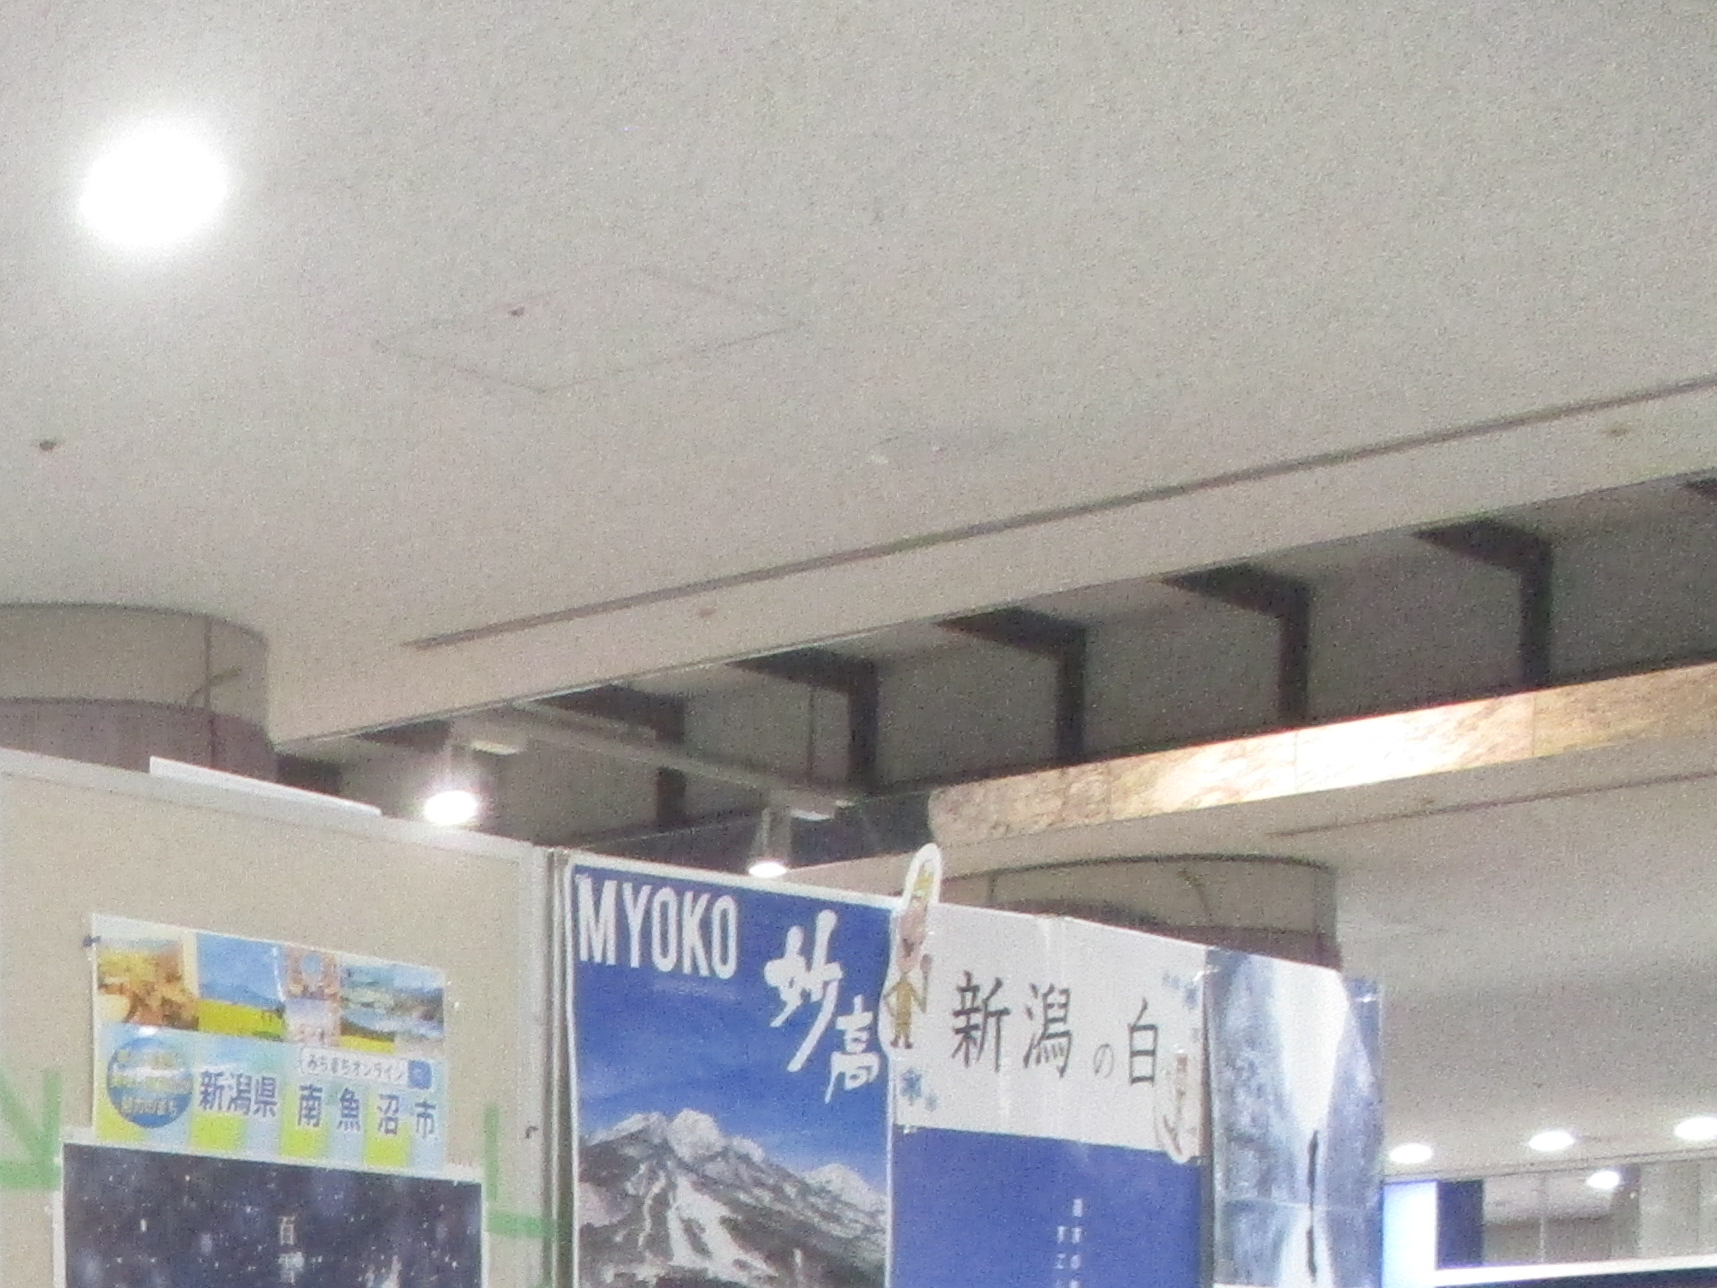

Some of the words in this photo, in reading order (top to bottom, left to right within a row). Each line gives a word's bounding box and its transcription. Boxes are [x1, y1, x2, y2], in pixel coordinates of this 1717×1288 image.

[575, 872, 739, 981] MYOKO
[763, 908, 881, 1105] 妙高
[951, 970, 1159, 1088] 新潟の白
[198, 1070, 279, 1119] 新潟県
[296, 1082, 438, 1140] 南魚沼市
